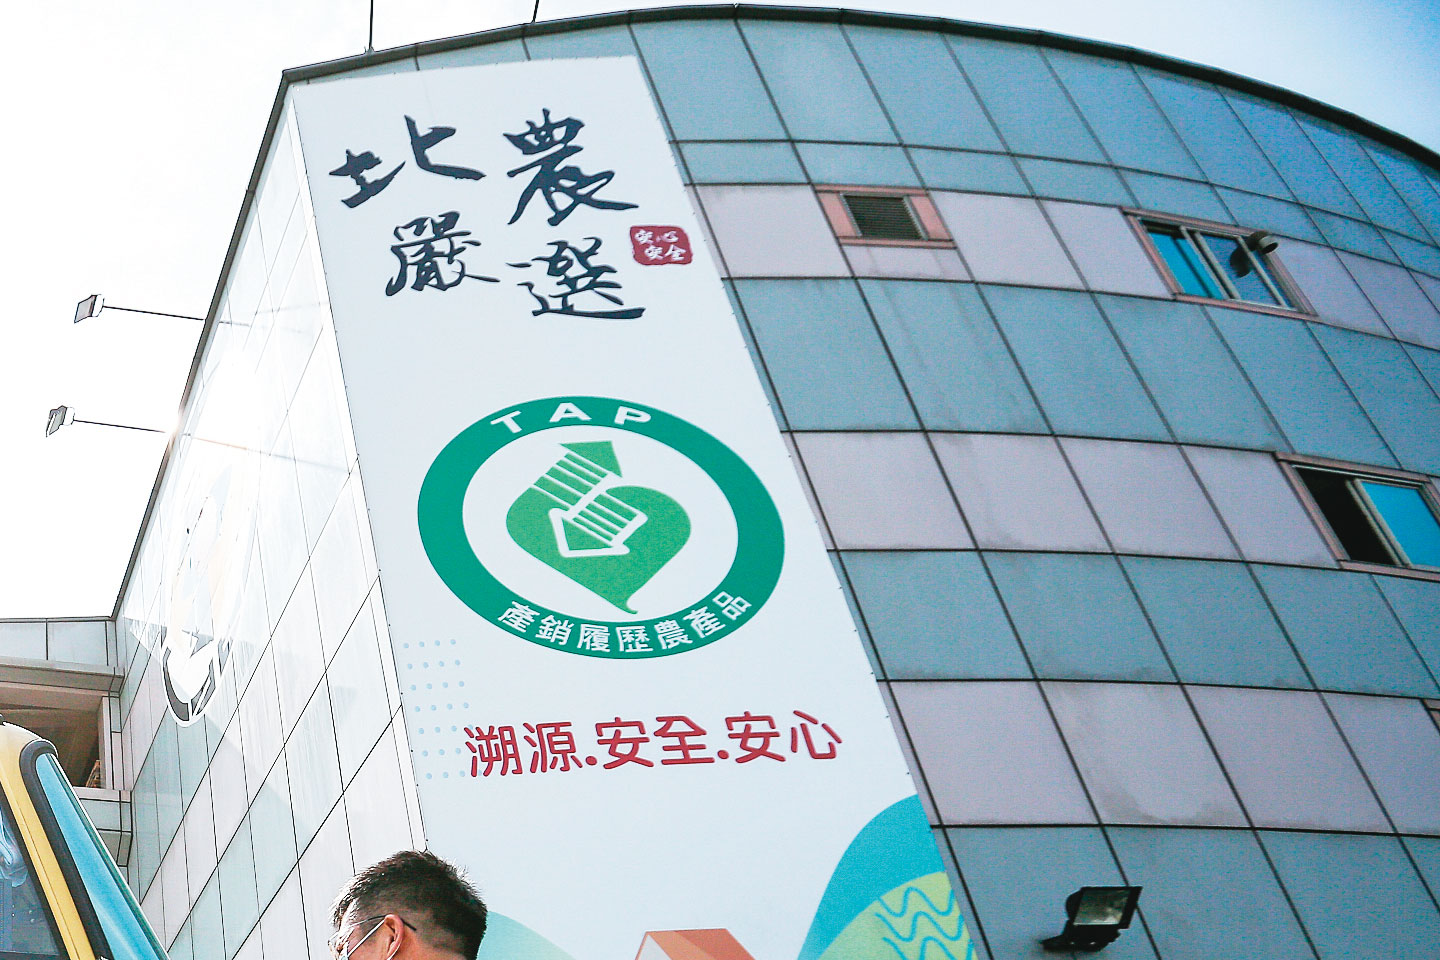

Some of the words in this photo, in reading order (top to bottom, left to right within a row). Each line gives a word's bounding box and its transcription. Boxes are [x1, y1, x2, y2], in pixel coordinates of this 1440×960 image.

[329, 108, 639, 226] 北農
[385, 211, 646, 319] 嚴選
[490, 402, 652, 434] TAP
[497, 590, 752, 652] 產銷履歷農產品
